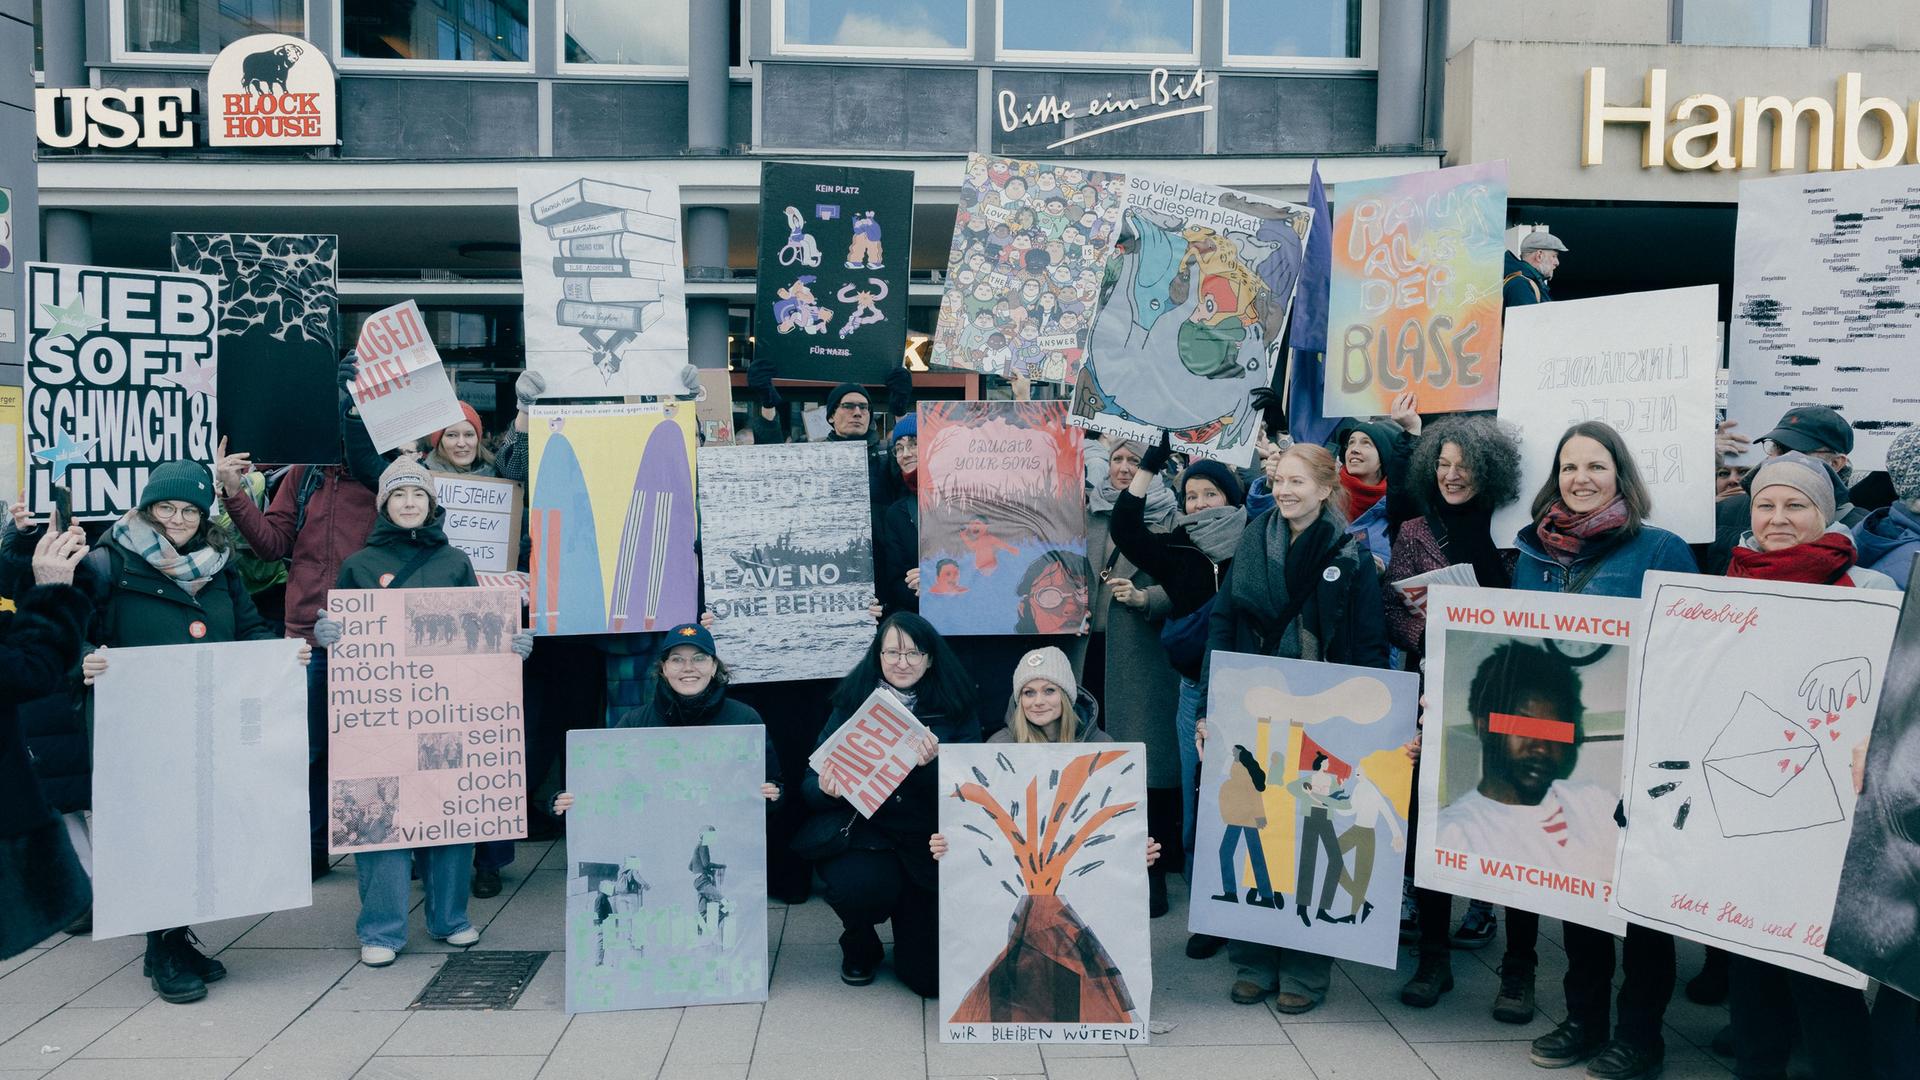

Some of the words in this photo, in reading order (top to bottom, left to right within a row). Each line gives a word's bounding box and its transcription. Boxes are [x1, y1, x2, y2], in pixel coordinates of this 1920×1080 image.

[222, 93, 320, 115] BLOCK
[998, 89, 1076, 132] Bitte
[1088, 92, 1140, 116] ein
[1150, 68, 1215, 107] Bit
[223, 115, 322, 138] HOUSE
[815, 184, 834, 194] KEIN
[835, 184, 860, 195] PLATZ
[1130, 177, 1150, 191] so
[1152, 181, 1178, 197] viel
[1179, 187, 1217, 207] platz
[986, 207, 1008, 221] LOVE
[1127, 193, 1154, 207] auf
[1153, 197, 1209, 220] diesem
[1349, 184, 1489, 261] RAUS
[1083, 248, 1093, 256] IS
[990, 276, 1006, 287] THE
[1360, 265, 1456, 318] DER
[33, 272, 211, 336] LIEB
[354, 307, 425, 366] UGEN
[1038, 337, 1076, 348] ANSWER
[32, 336, 209, 388] SOFT
[810, 346, 825, 355] FÜR
[1341, 314, 1485, 394] BLASE
[32, 387, 184, 466] SCHWACH
[187, 391, 210, 463] &
[34, 465, 149, 514] LIN
[449, 513, 500, 531] GEGEN
[455, 545, 495, 559] CHTS
[710, 564, 793, 589] LEAVE
[799, 563, 841, 586] NO
[330, 593, 374, 613] soll
[712, 597, 768, 620] ONE
[775, 590, 872, 616] BEHIND
[1665, 598, 1759, 634] Liebesbriefe
[1446, 606, 1496, 625] WHO
[1503, 610, 1550, 630] WILL
[1554, 614, 1630, 637] WATCH
[331, 642, 395, 659] kann
[331, 660, 434, 682] möchte
[331, 687, 402, 706] muss
[411, 682, 449, 702] ich
[332, 707, 399, 734] jetzt
[407, 701, 521, 730] politisch
[468, 724, 521, 745] sein
[466, 747, 522, 768] nein
[823, 703, 911, 795] AUGEN
[457, 769, 522, 792] doch
[442, 793, 524, 816] sicher
[402, 815, 525, 842] vielleicht
[1434, 849, 1468, 871] THE
[1480, 857, 1595, 899] WATCHMEN
[1603, 885, 1613, 903] ?
[1761, 922, 1798, 939] und
[1802, 924, 1826, 948] He
[1063, 1023, 1146, 1041] WÜTEND!
